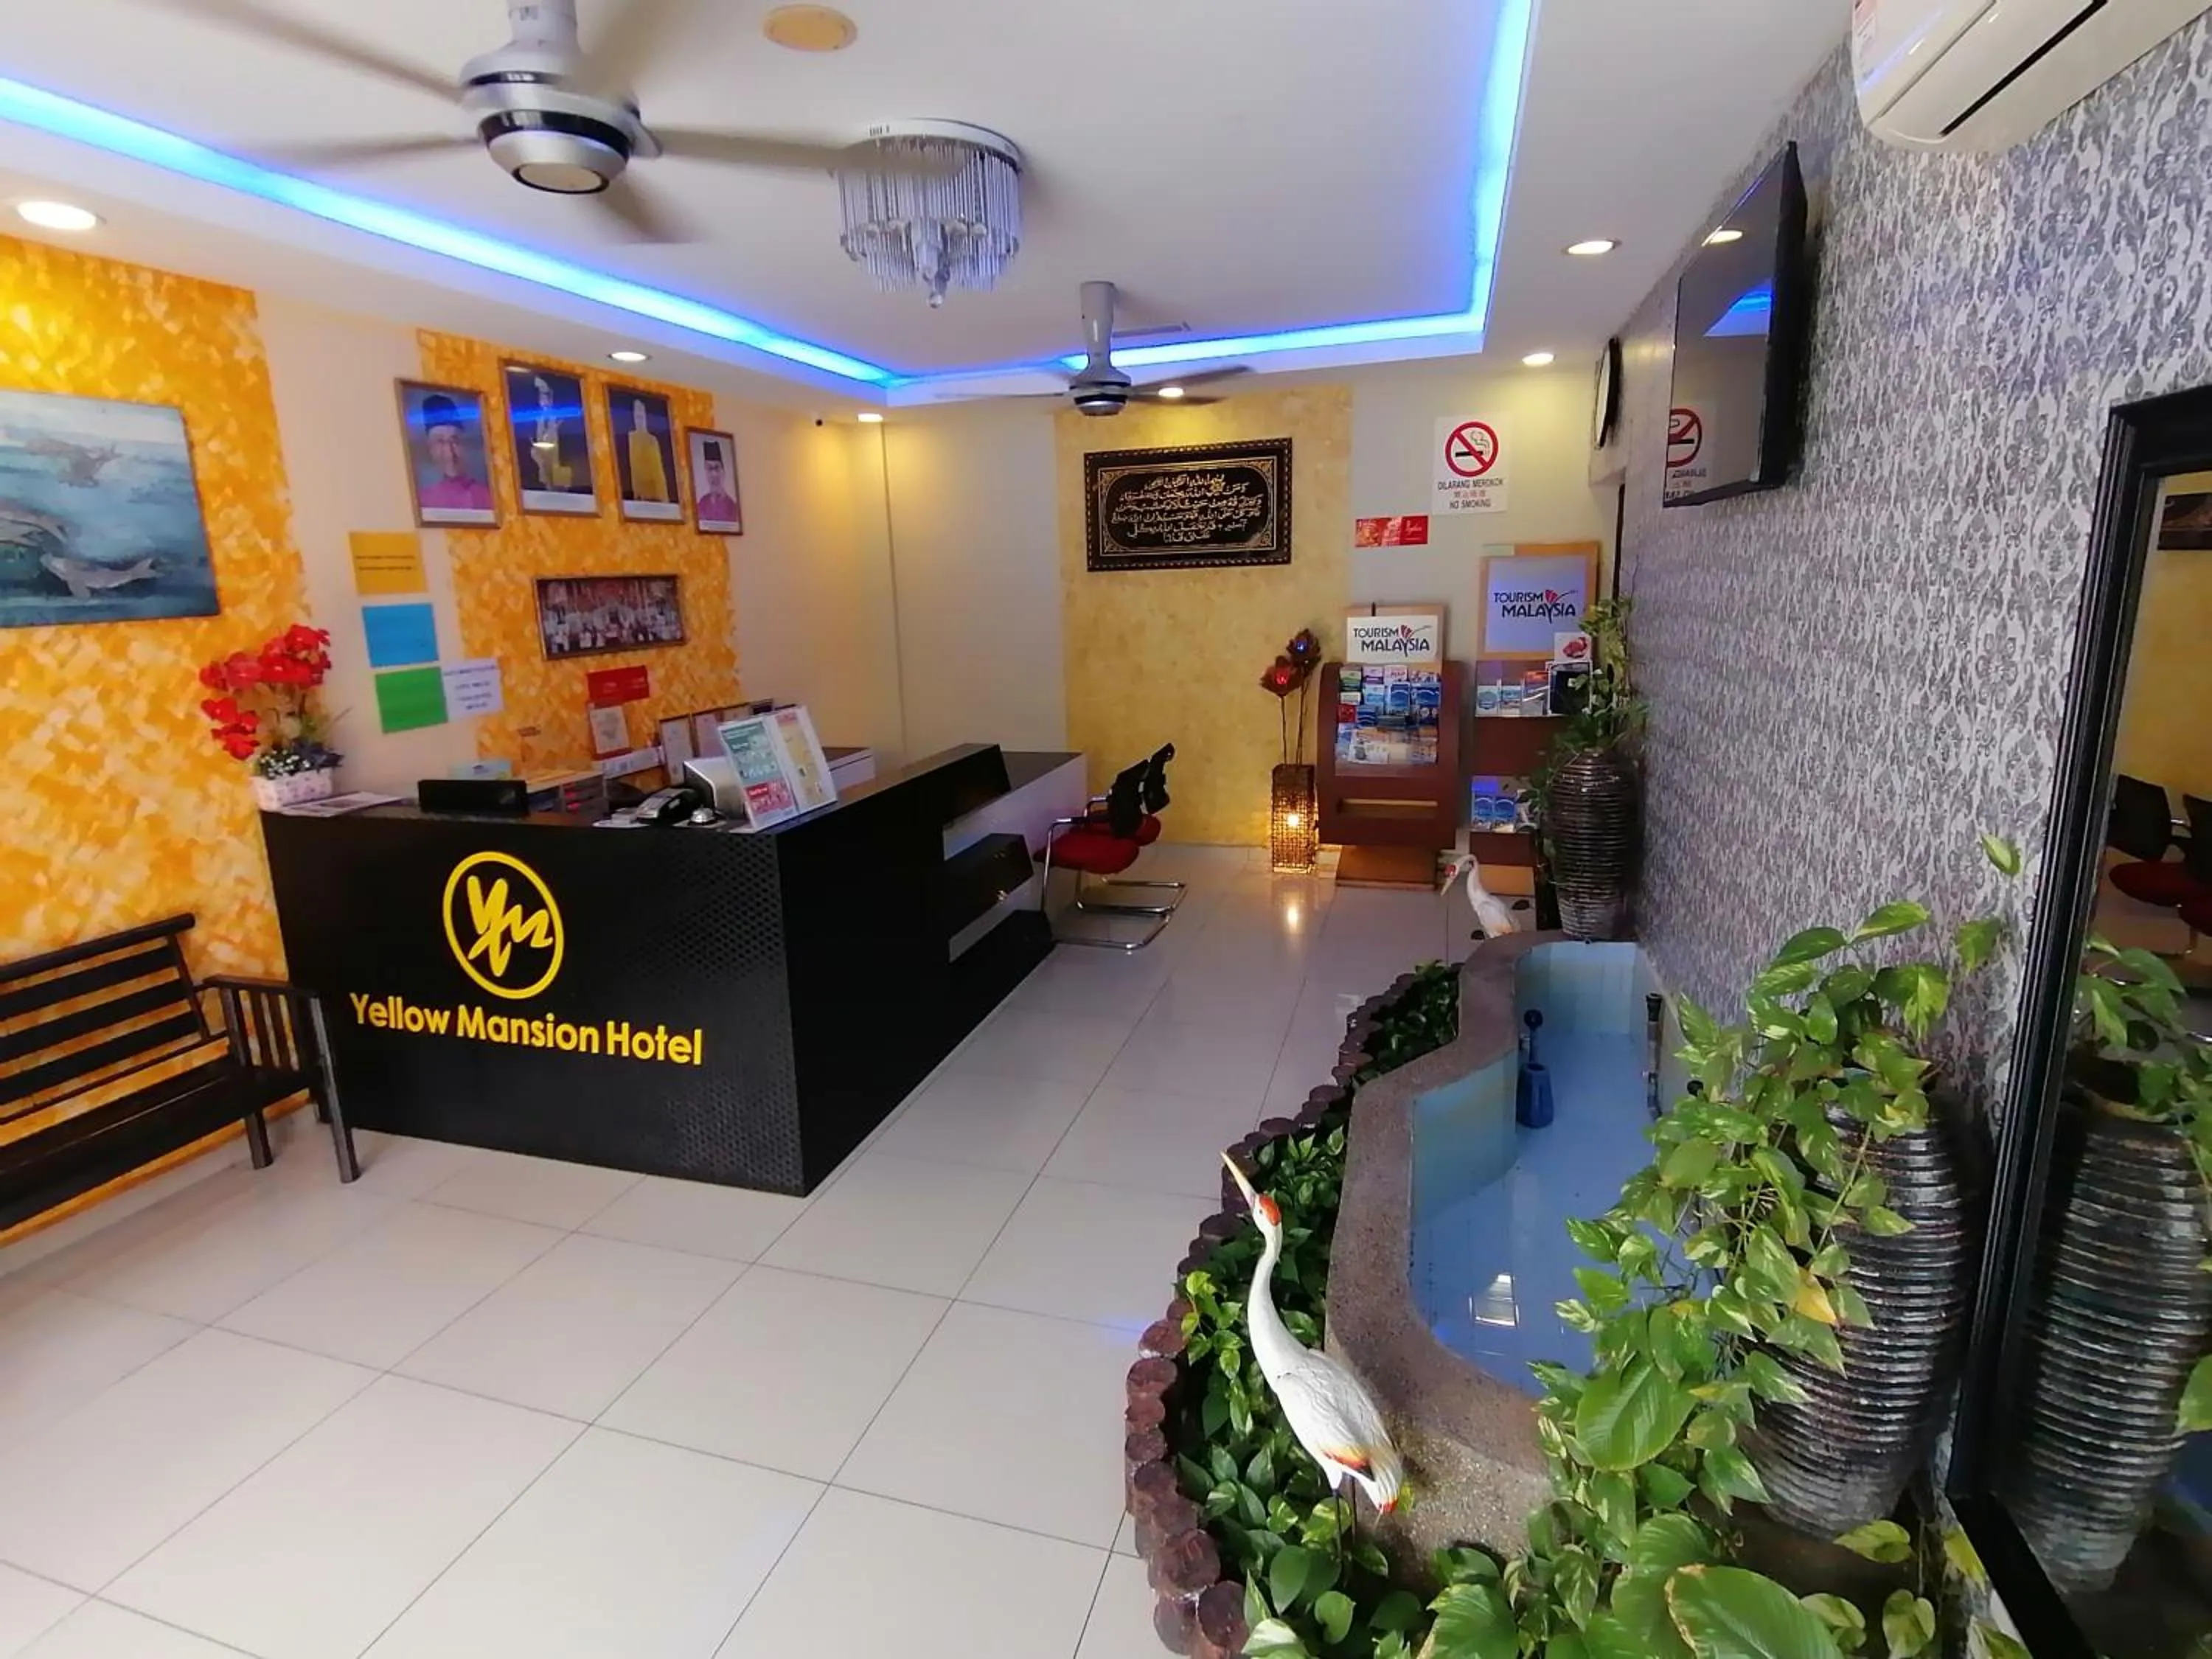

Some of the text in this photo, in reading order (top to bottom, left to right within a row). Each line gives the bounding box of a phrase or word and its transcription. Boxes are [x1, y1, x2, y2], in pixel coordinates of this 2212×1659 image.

[1438, 479, 1470, 490] DILARANG
[1450, 498, 1491, 509] NO SMOKING
[1493, 591, 1543, 603] TOURISM
[1501, 602, 1576, 624] MALAYSIA
[1353, 627, 1399, 639] TOURISM
[1361, 638, 1430, 658] MALAYSIA
[349, 992, 703, 1066] Yellow Mansion Hotel
